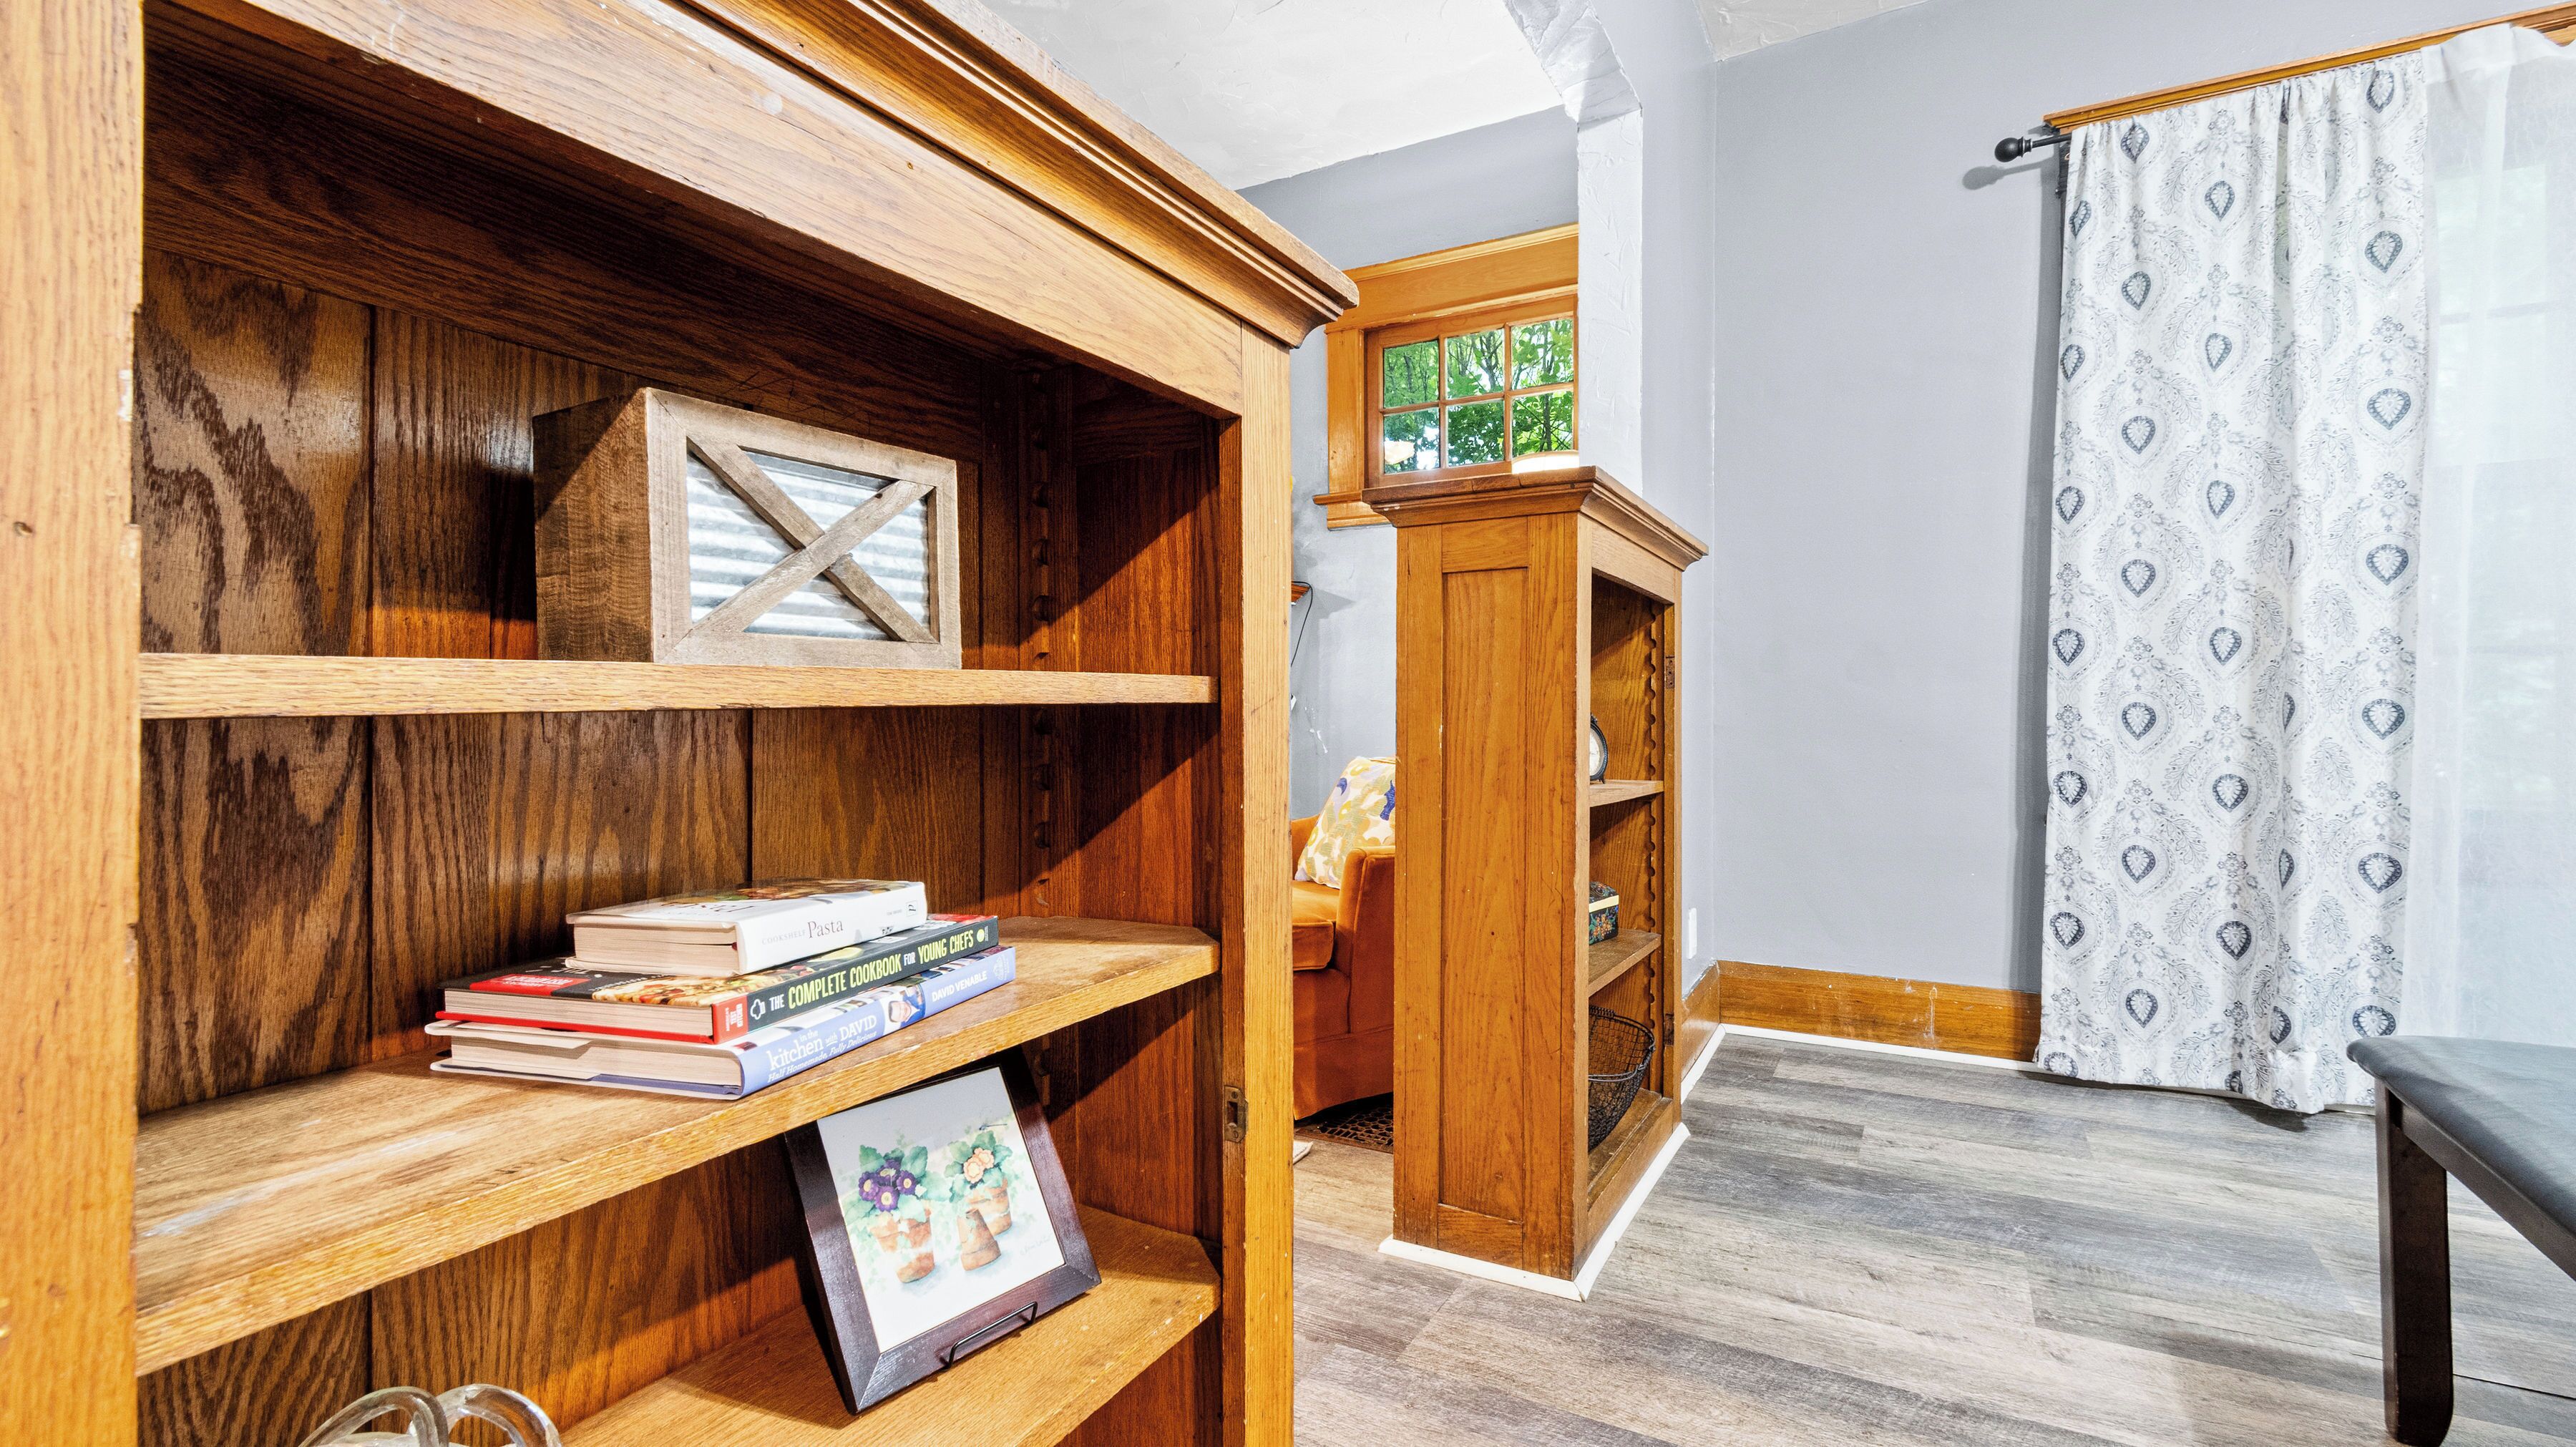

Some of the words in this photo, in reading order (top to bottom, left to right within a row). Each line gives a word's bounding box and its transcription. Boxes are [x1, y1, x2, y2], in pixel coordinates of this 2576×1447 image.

[761, 929, 807, 945] COOKSHELF
[808, 919, 844, 939] Pasta
[769, 994, 785, 1011] THE
[789, 970, 847, 1009] COMPLETE
[850, 953, 902, 988] COOKBOOK
[903, 952, 916, 966] FOR
[918, 936, 947, 964] YOUNG
[950, 930, 974, 955] CHEFS
[932, 984, 955, 1002] DAVID
[955, 970, 987, 992] VENABLE
[766, 1038, 824, 1071] kitchen
[825, 1033, 838, 1043] with
[839, 1015, 877, 1041] DAVID
[768, 1067, 786, 1083] Half
[829, 1043, 847, 1056] Fully
[847, 1031, 877, 1048] Delicious
[800, 1033, 808, 1043] in
[809, 1030, 819, 1039] the
